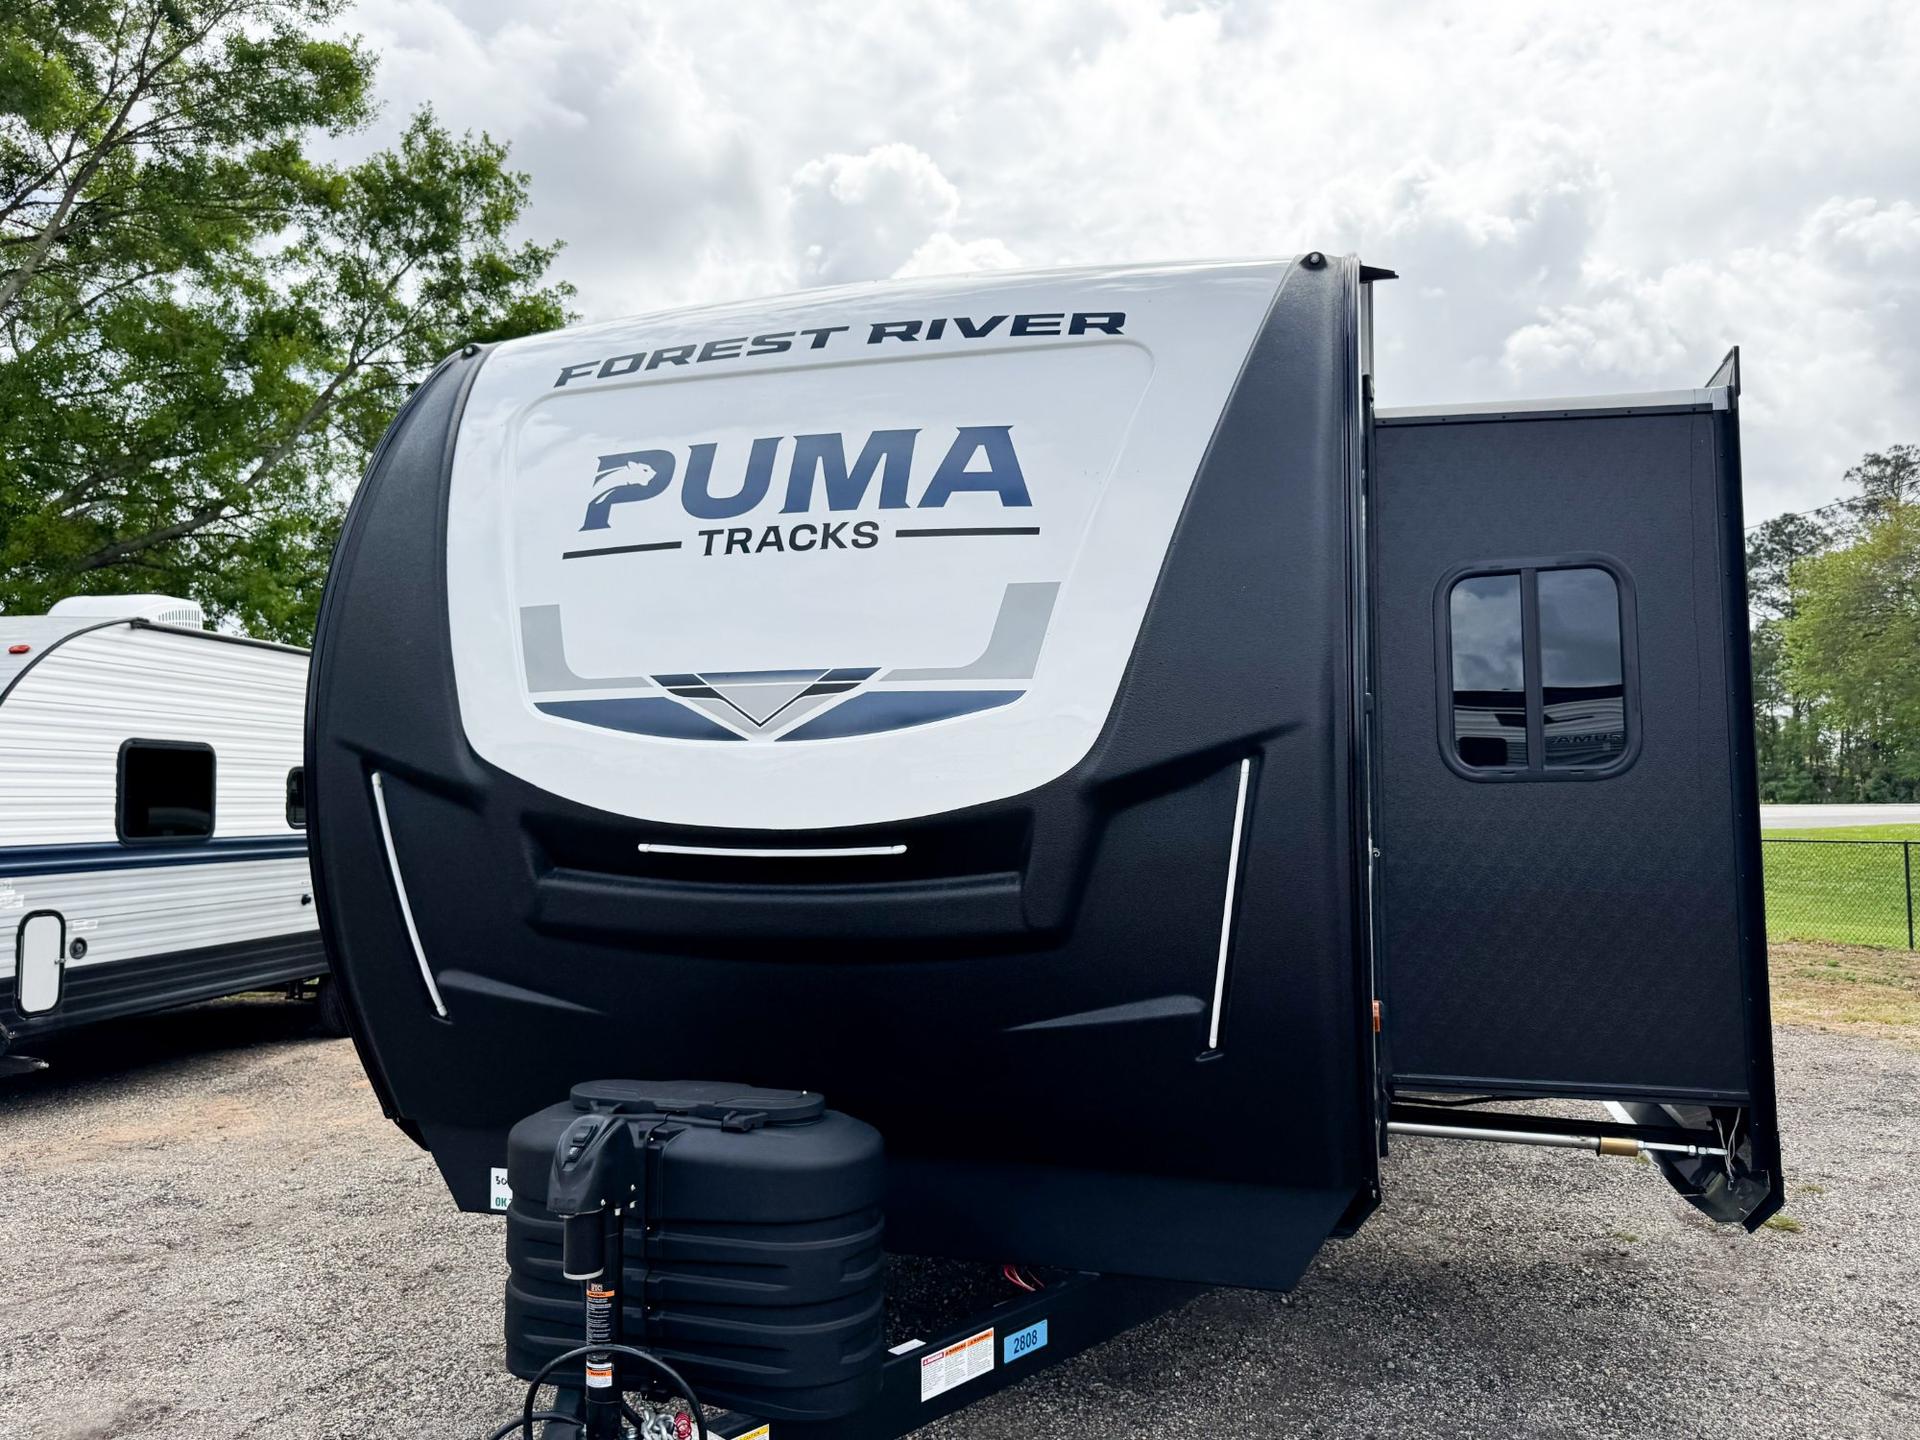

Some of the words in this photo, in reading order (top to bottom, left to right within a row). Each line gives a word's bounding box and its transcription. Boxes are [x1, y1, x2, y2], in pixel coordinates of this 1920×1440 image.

[553, 325, 849, 388] FOREST
[867, 312, 1126, 345] RIVER
[579, 425, 1033, 532] PUMA
[698, 521, 880, 557] TRACKS
[1013, 1329, 1038, 1355] 2808
